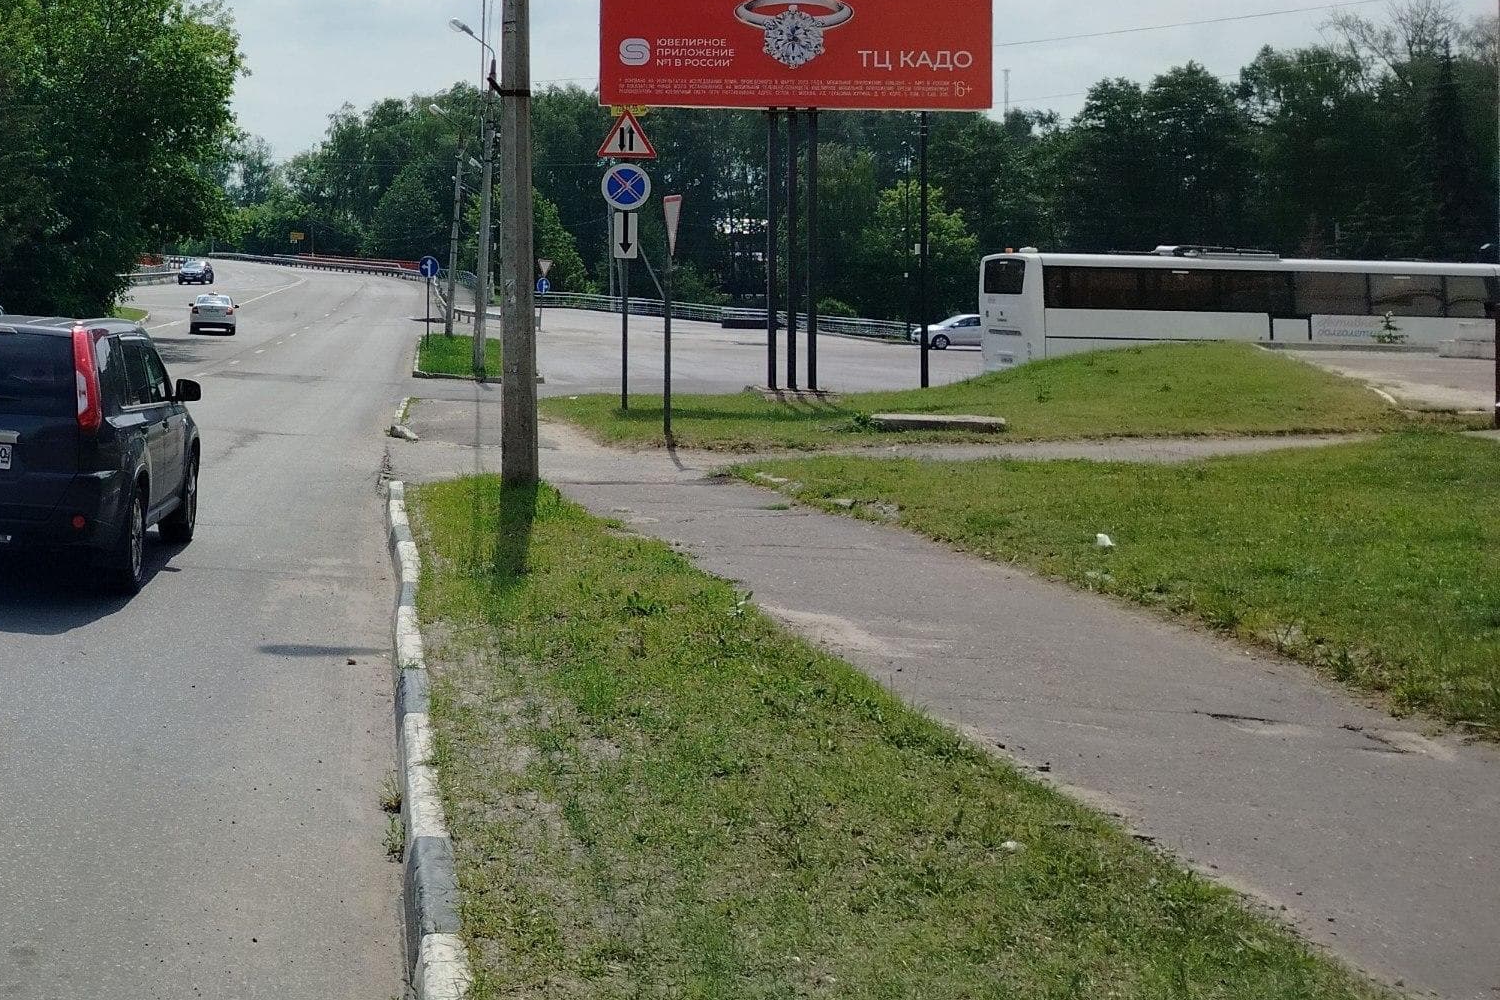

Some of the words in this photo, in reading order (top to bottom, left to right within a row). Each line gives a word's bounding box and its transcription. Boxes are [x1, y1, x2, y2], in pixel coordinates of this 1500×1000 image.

[656, 38, 727, 47] ЮВЕЛИРНОЕ
[656, 48, 735, 57] ПРИЛОЖЕНИЕ
[674, 58, 682, 67] В
[857, 50, 892, 71] ТЦ
[899, 50, 973, 71] КАДО
[953, 80, 973, 97] 16+
